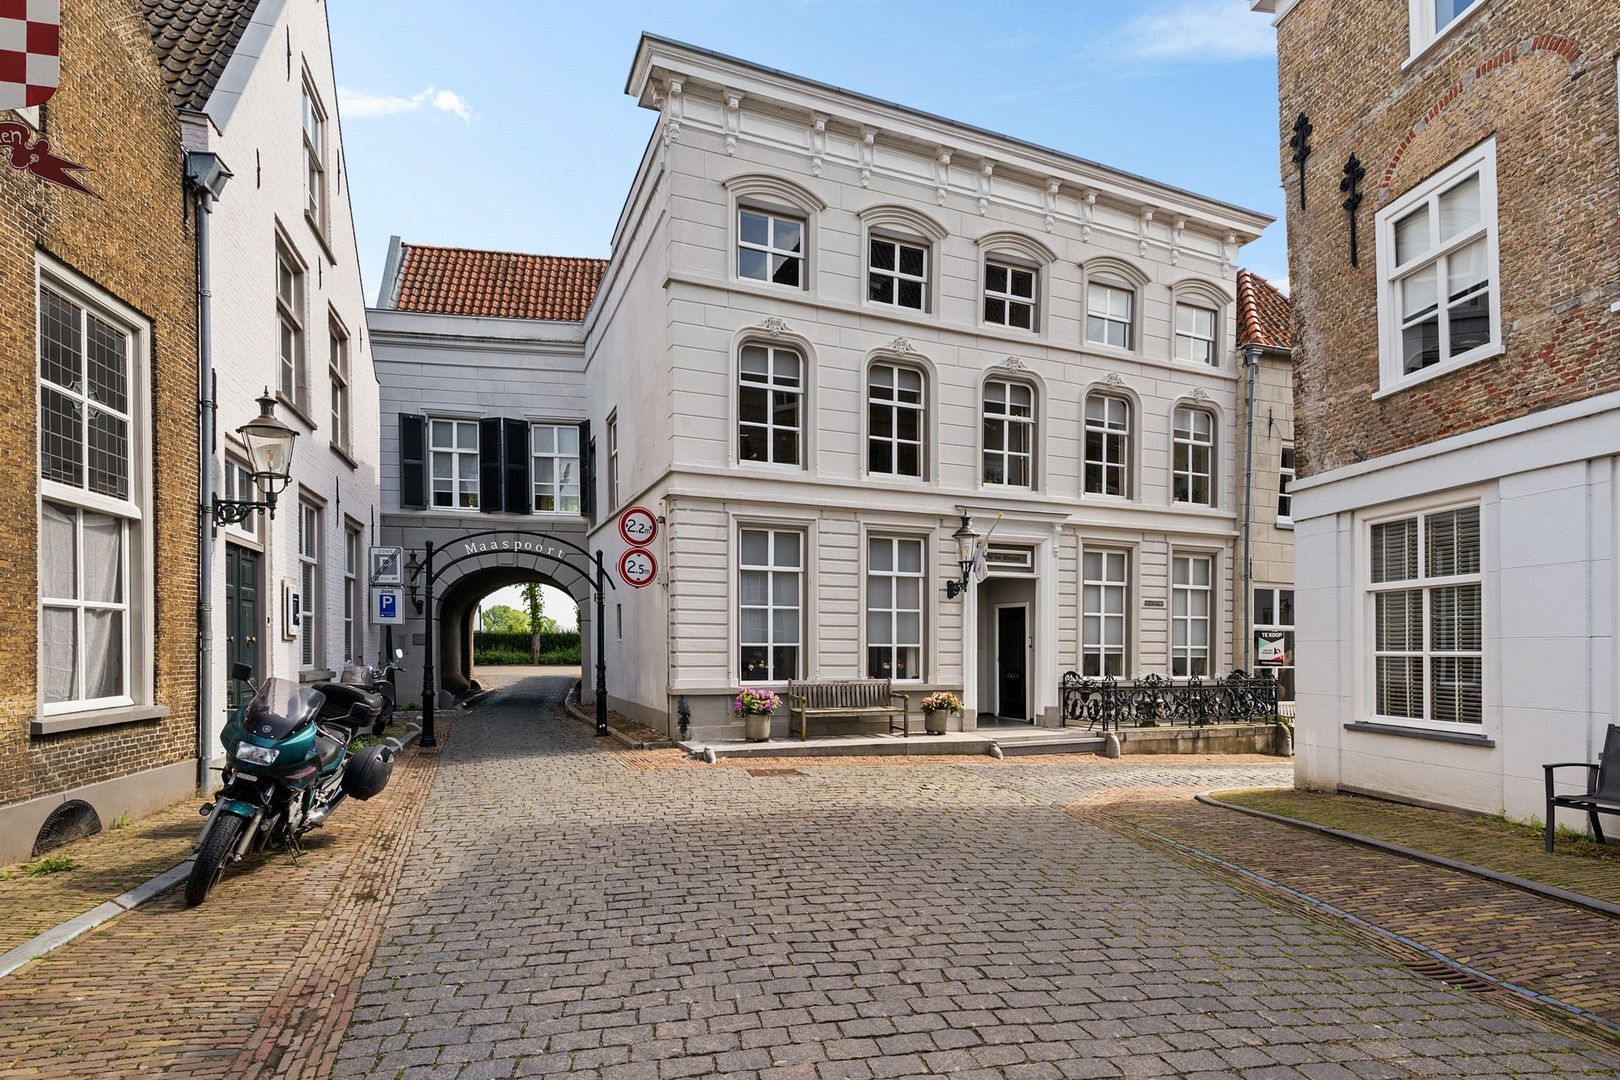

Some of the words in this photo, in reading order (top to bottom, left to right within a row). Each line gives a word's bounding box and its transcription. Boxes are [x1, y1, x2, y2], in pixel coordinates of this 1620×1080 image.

[0, 130, 22, 144] en
[464, 540, 564, 559] Maaspoort
[383, 596, 393, 608] P
